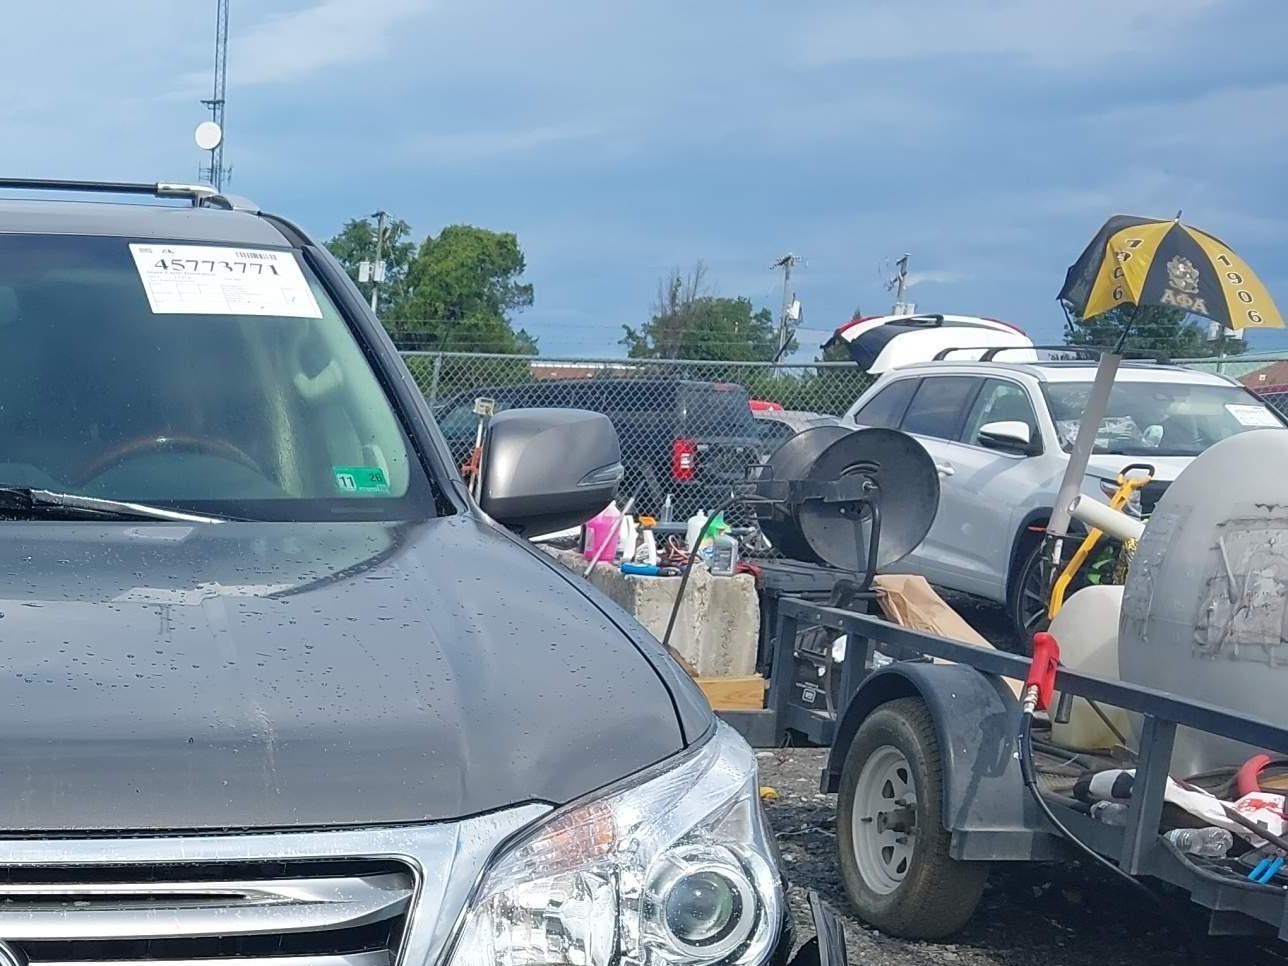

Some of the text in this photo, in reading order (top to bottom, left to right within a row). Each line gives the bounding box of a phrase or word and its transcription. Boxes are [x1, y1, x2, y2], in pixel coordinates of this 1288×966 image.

[154, 258, 280, 276] 45773771
[1217, 254, 1263, 323] 1906
[338, 475, 355, 489] 11
